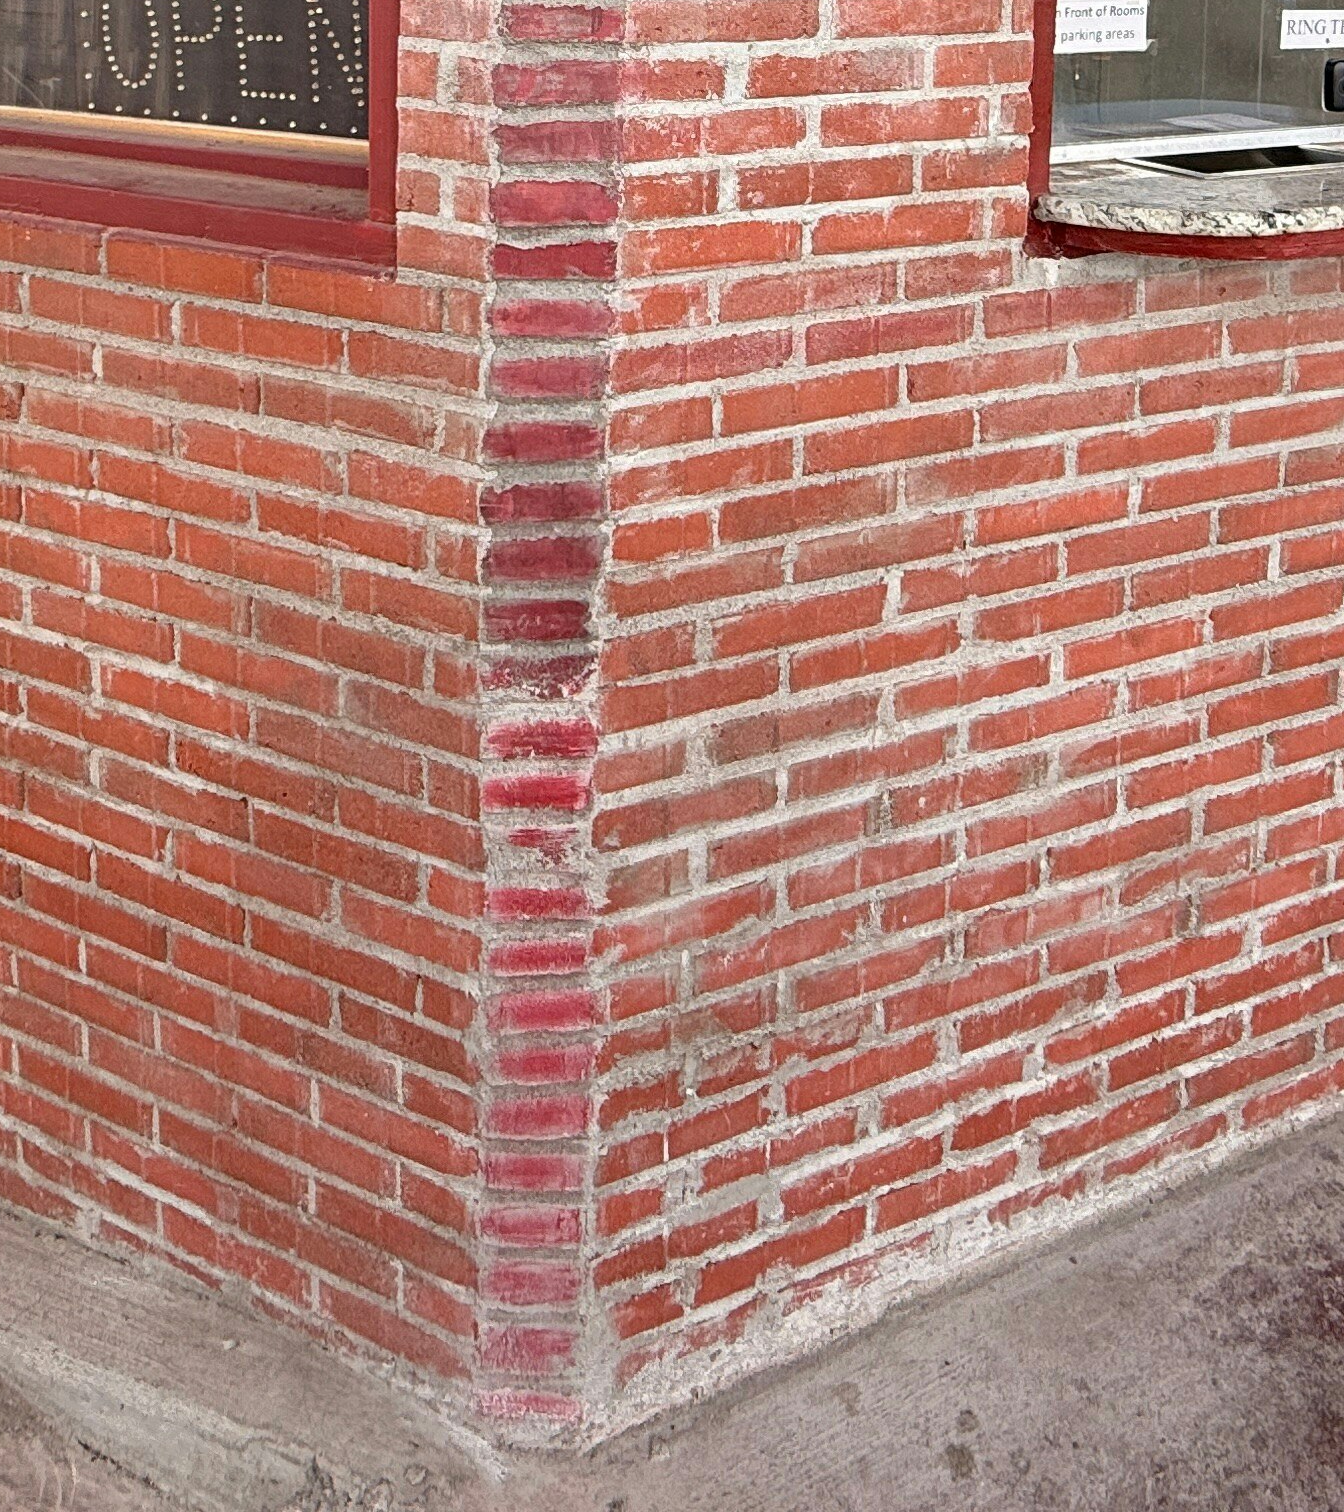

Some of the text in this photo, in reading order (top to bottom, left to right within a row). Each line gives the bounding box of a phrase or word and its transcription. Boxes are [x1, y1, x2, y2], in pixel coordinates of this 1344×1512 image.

[1065, 6, 1093, 18] Front
[1095, 5, 1108, 18] of
[1109, 5, 1145, 17] Rooms
[1286, 18, 1327, 35] RING
[1061, 29, 1135, 44] parking areas
